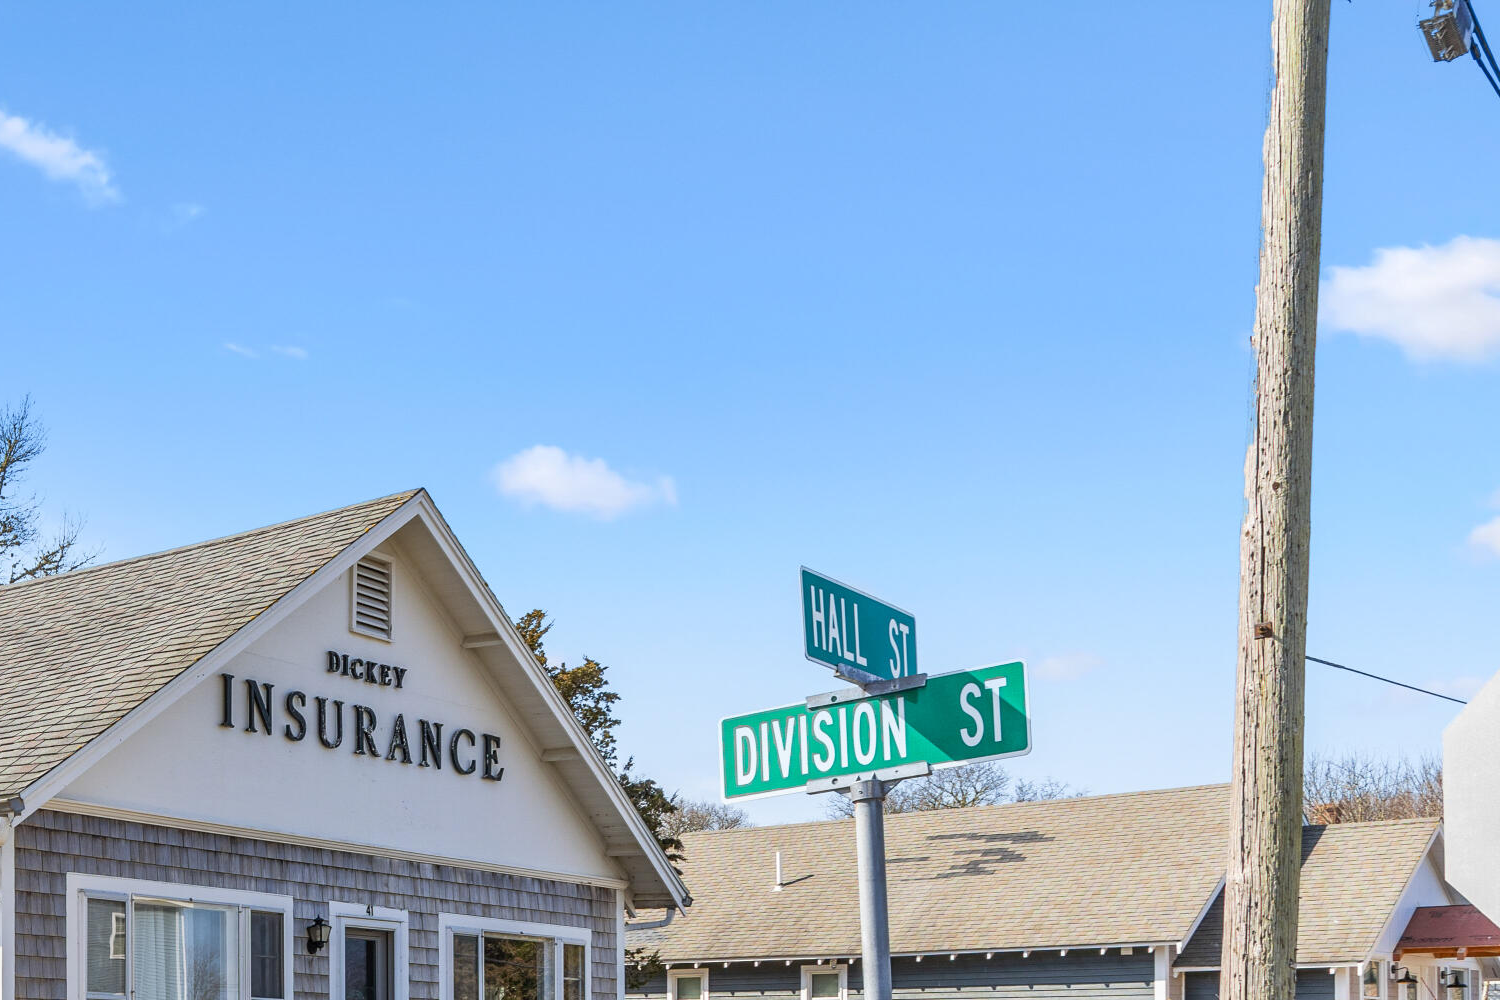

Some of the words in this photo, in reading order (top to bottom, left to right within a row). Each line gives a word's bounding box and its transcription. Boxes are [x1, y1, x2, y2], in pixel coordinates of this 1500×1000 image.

[327, 650, 408, 689] DICKEY
[810, 584, 868, 667] HALL
[888, 618, 910, 679] ST
[220, 672, 505, 782] INSURANCE
[734, 696, 907, 787] DIVISION
[959, 676, 1007, 748] ST
[366, 904, 374, 917] 41
